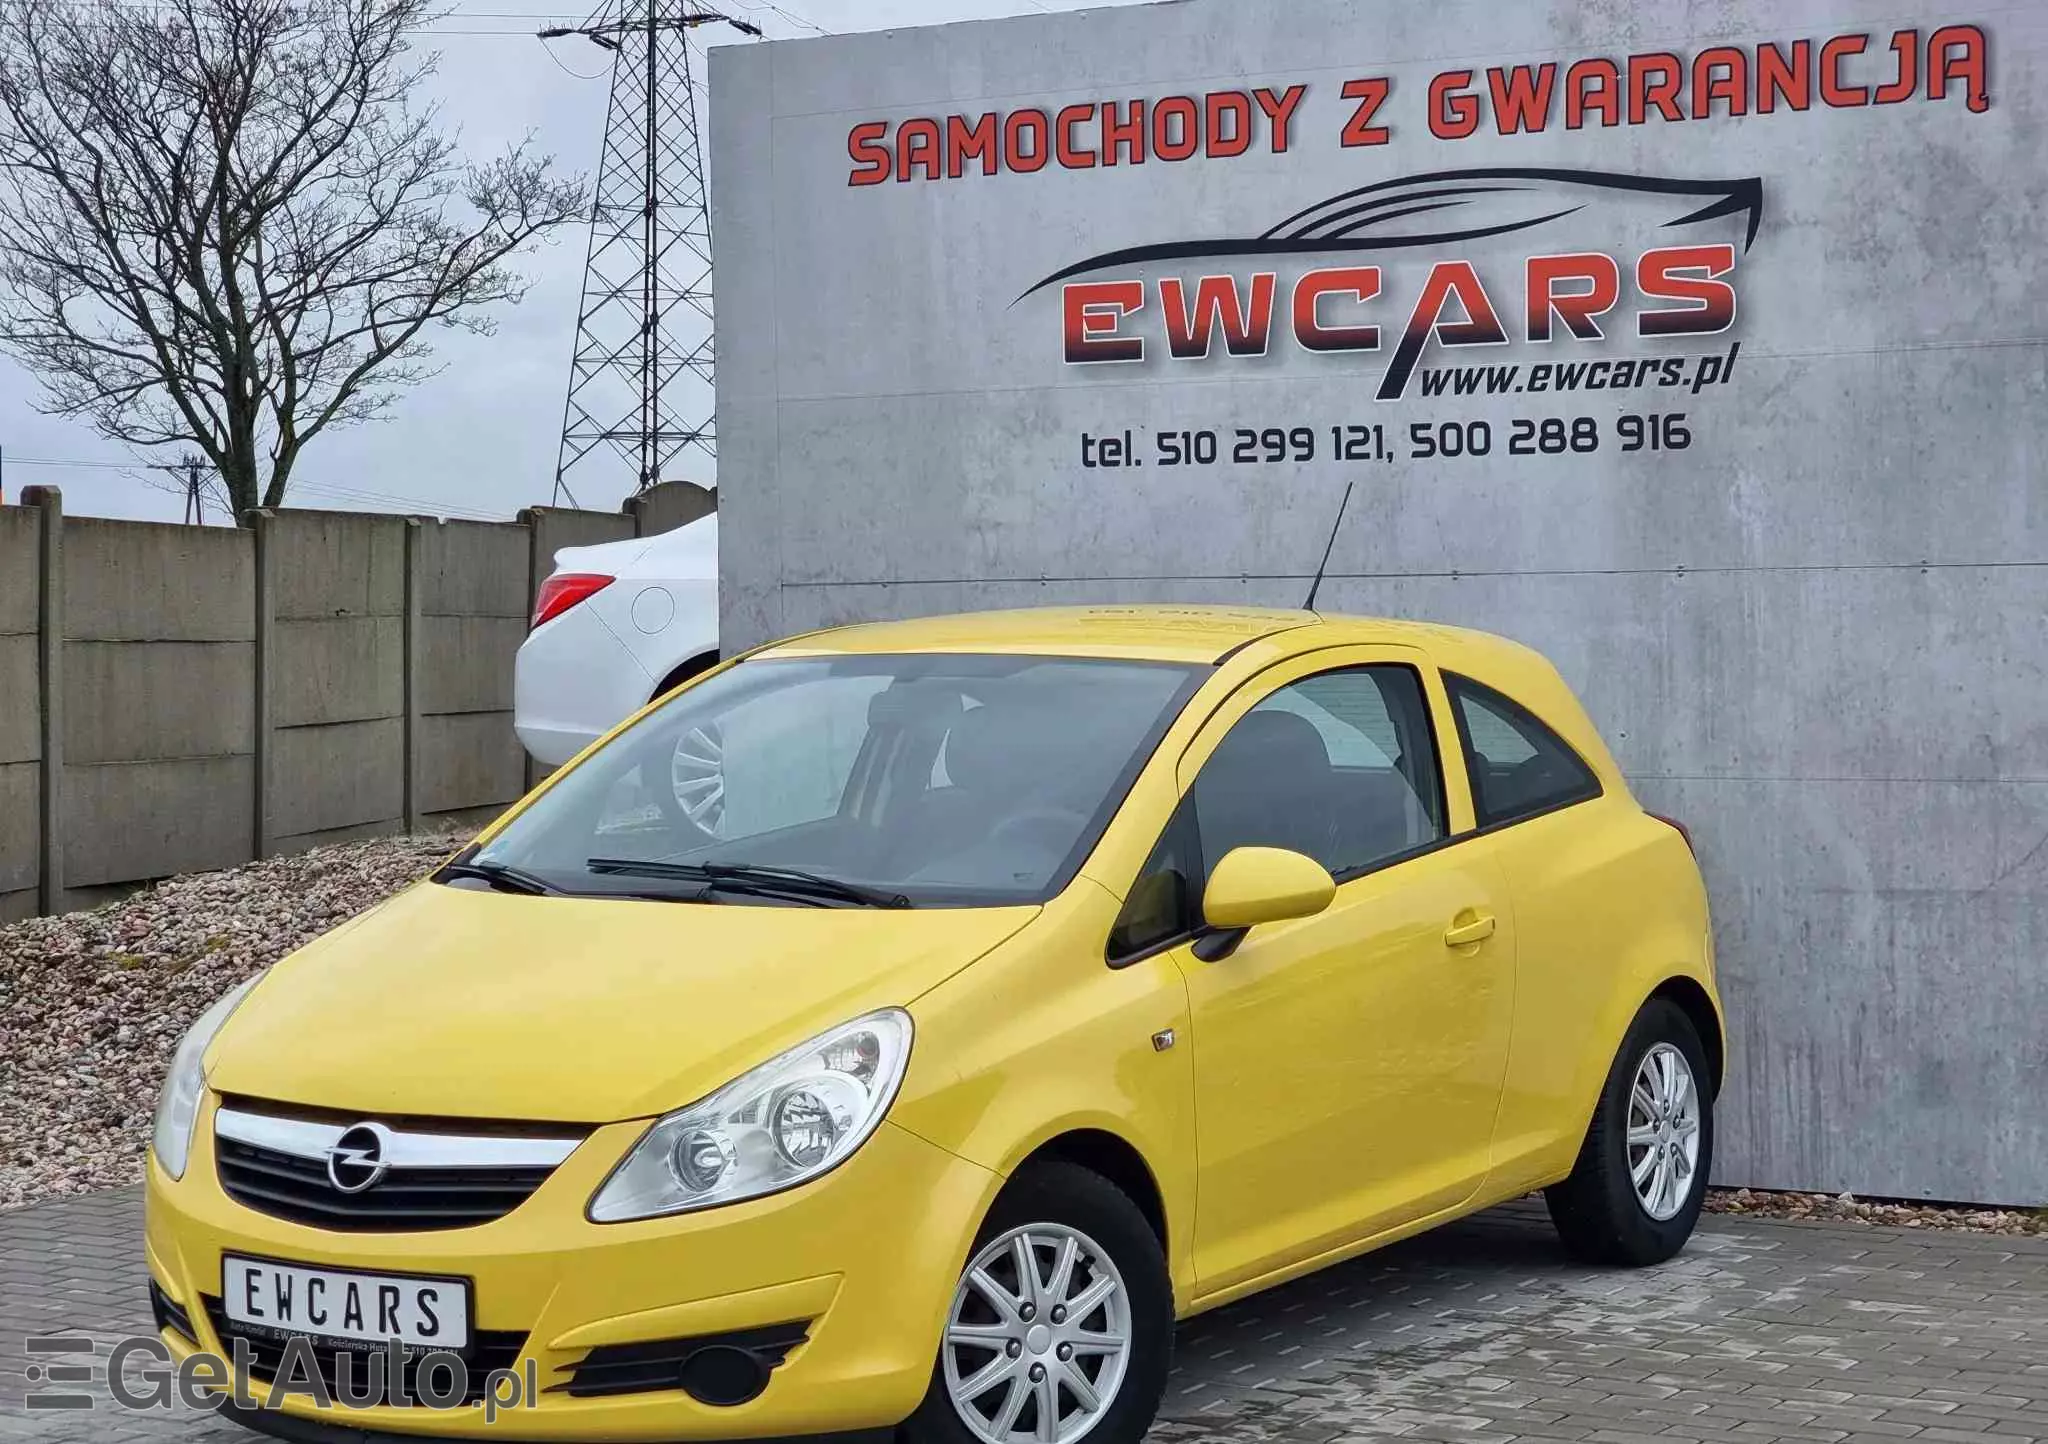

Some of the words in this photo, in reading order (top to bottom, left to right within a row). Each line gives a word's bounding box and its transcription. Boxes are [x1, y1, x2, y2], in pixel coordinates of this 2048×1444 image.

[848, 84, 1308, 187] SAMOCHODY
[1340, 77, 1390, 148] Z
[1427, 24, 1990, 140] GWARANCJĄ
[1062, 243, 1736, 400] EWCARS
[1421, 342, 1741, 397] www.ewcars.pl
[1082, 430, 1142, 468] tel.
[1157, 431, 1217, 466] 510
[1233, 427, 1314, 463] 299
[1332, 424, 1394, 463] 121,
[1410, 420, 1491, 458] 500
[1508, 416, 1599, 454] 288
[1617, 412, 1692, 450] 916
[245, 1267, 440, 1338] EWCARS
